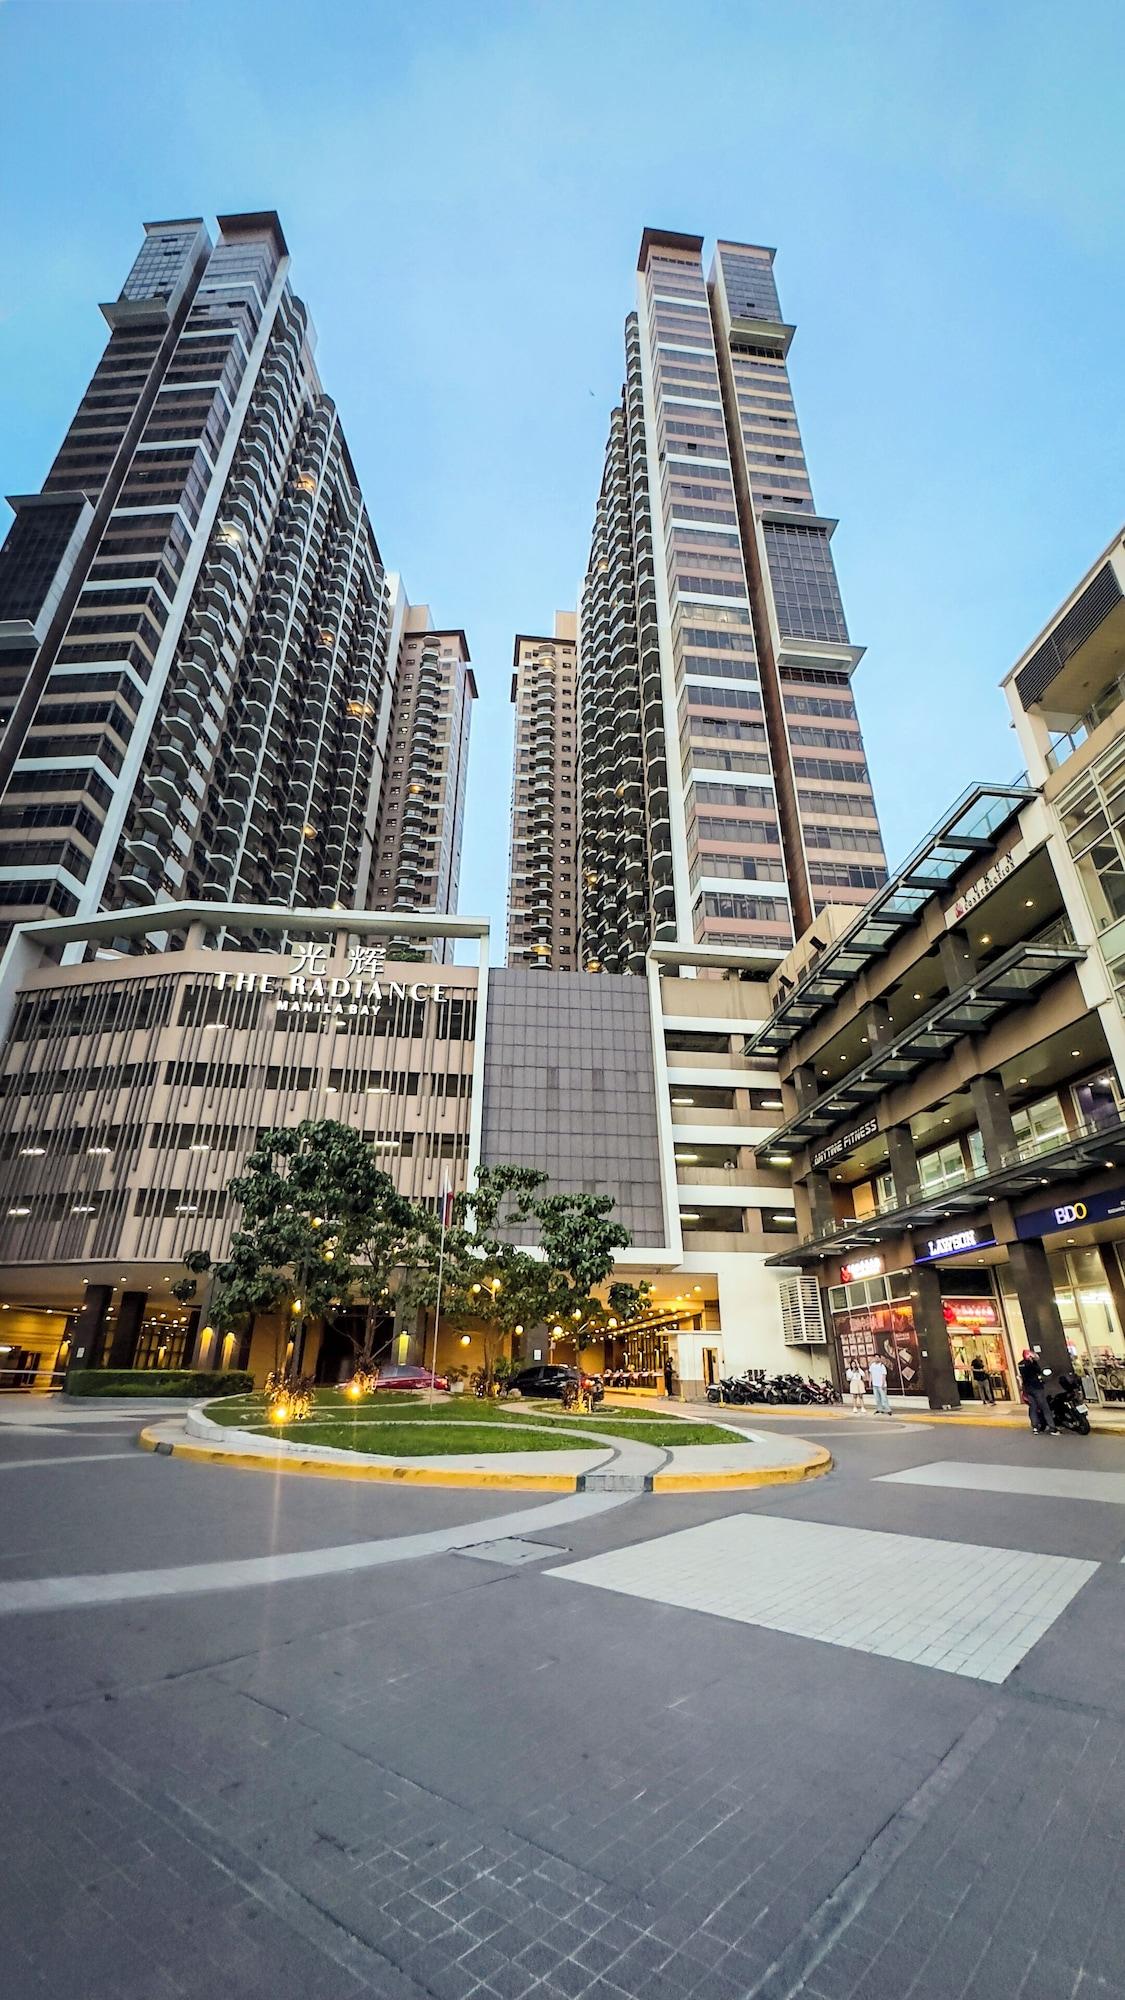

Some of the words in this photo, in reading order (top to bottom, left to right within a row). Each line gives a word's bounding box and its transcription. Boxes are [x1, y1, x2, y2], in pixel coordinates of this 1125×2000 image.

[289, 942, 386, 979] 光辉
[214, 972, 277, 993] THE
[289, 975, 448, 1002] RADIANCE
[277, 1000, 343, 1014] MANILA
[349, 1003, 381, 1015] BAY
[843, 1118, 877, 1148] FITNESS
[1054, 1202, 1087, 1225] BDO
[928, 1230, 976, 1256] LAWSON
